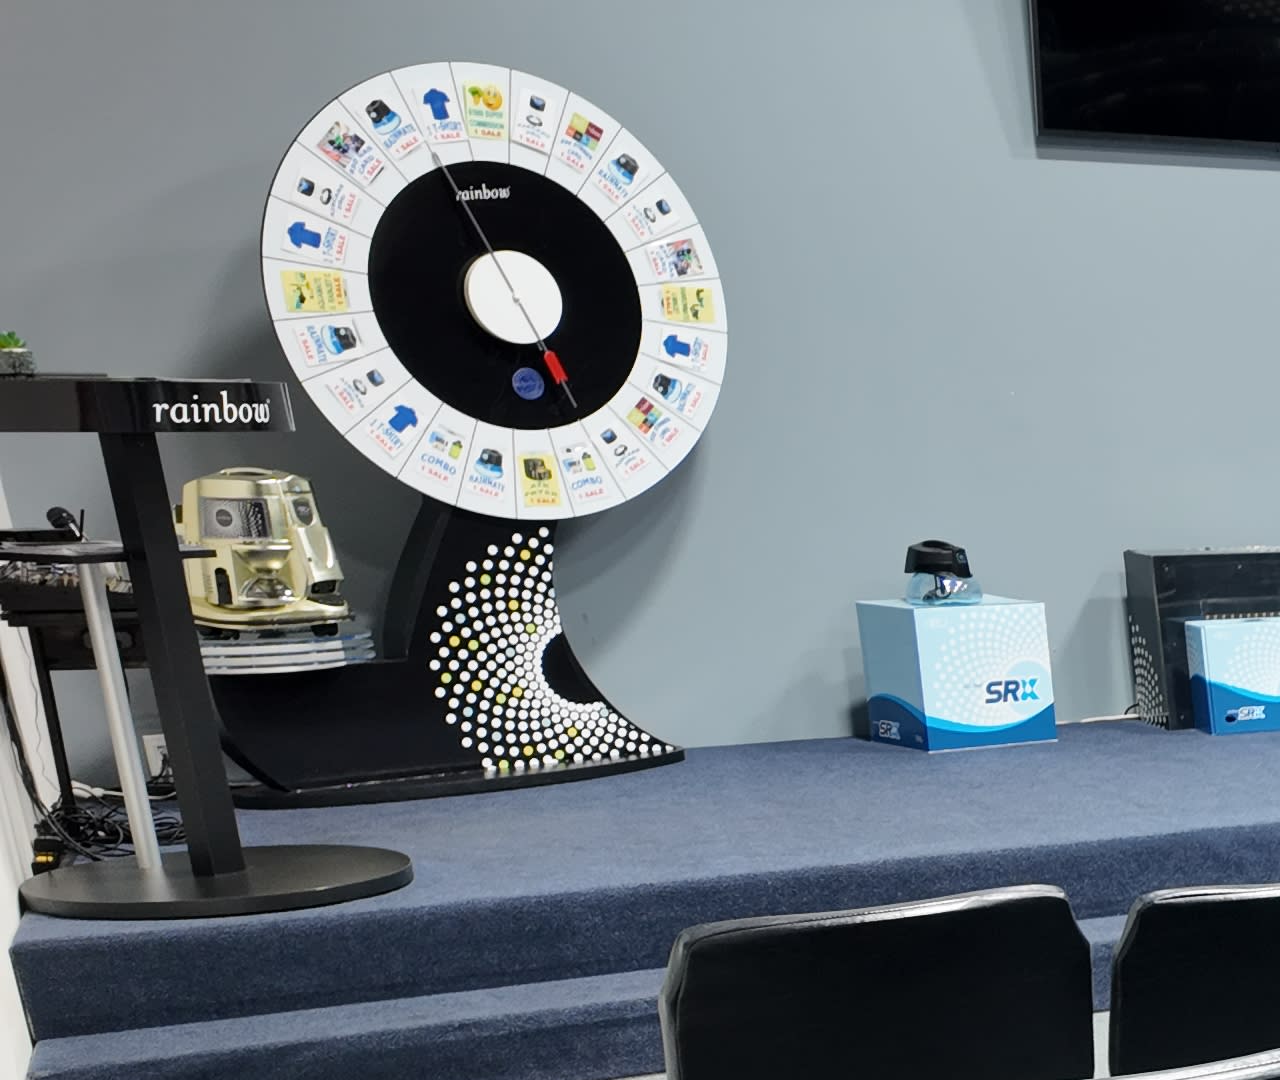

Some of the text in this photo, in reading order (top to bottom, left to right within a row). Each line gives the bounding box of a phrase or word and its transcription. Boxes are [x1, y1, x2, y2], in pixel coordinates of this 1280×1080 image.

[456, 183, 510, 201] rainbow
[152, 390, 270, 423] rainbow
[421, 453, 457, 476] COMBO
[571, 476, 602, 490] COMBO
[985, 678, 1040, 704] SRX
